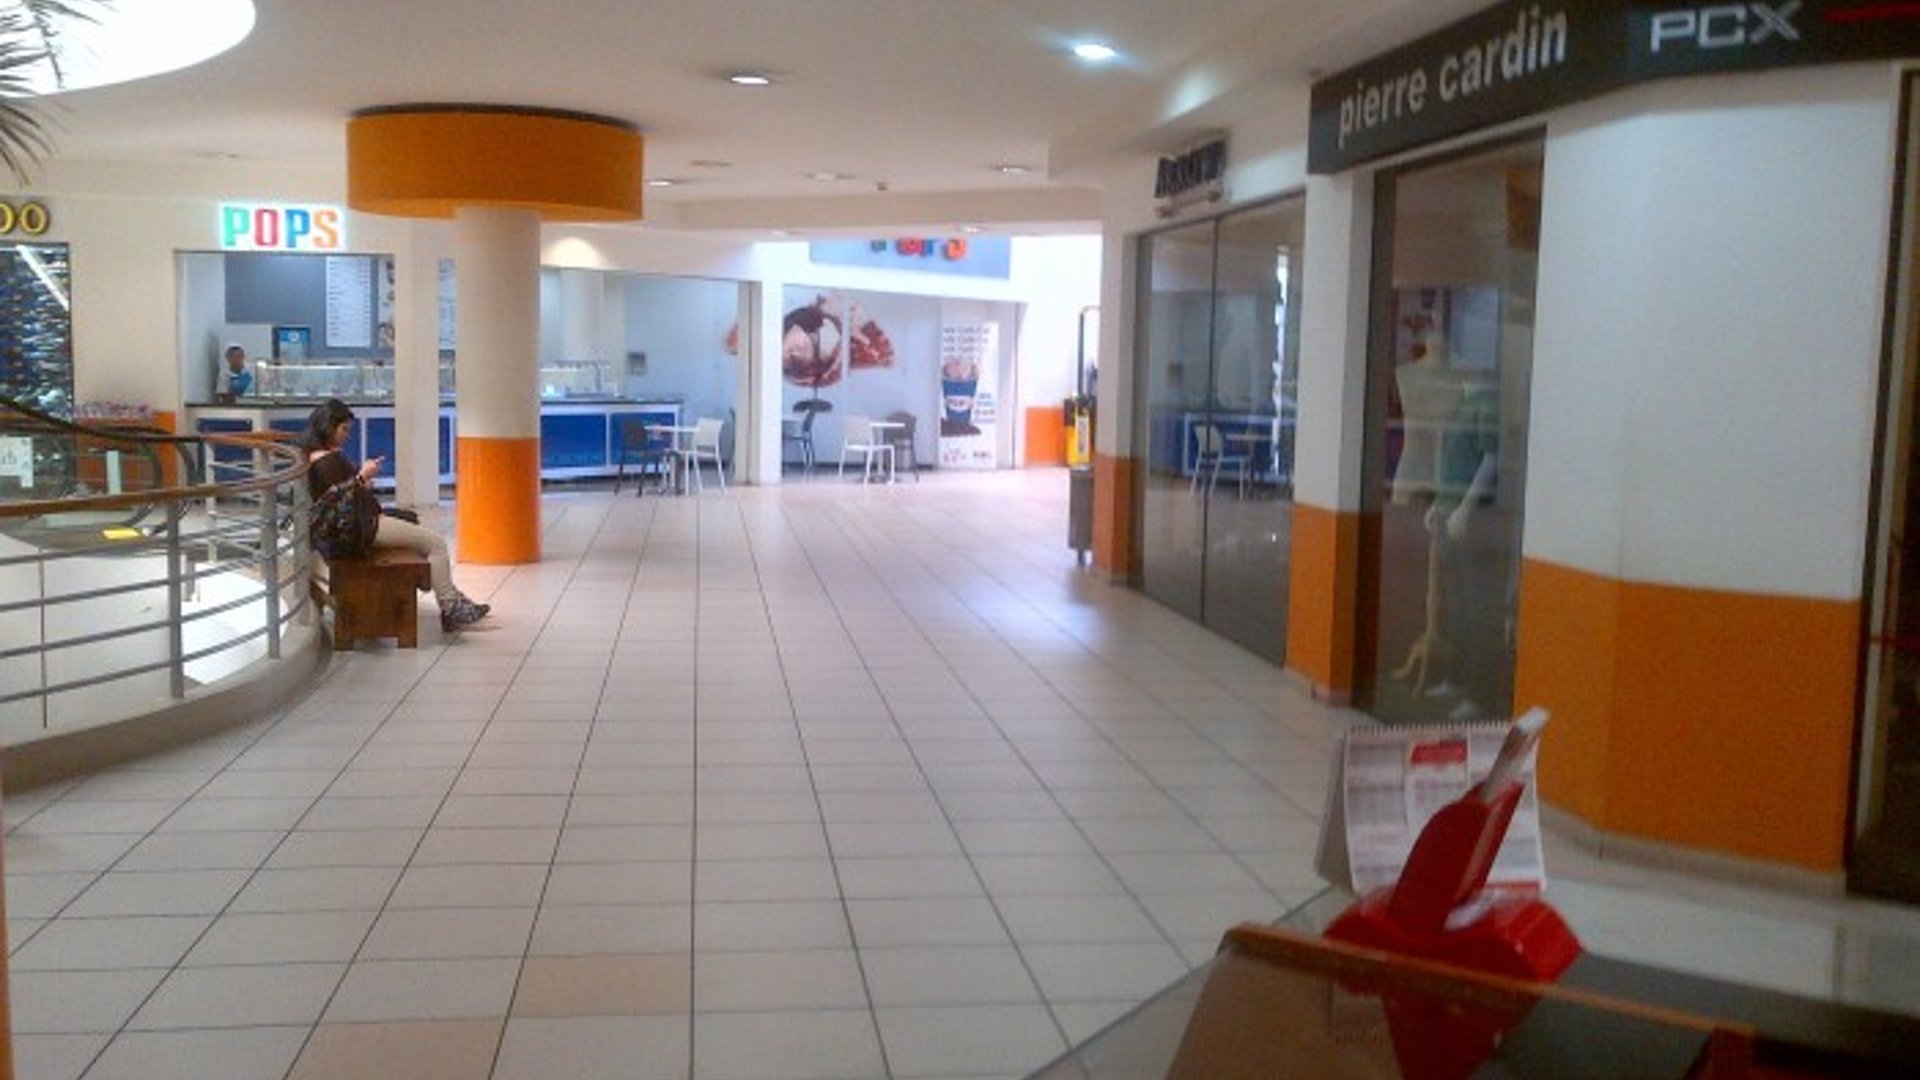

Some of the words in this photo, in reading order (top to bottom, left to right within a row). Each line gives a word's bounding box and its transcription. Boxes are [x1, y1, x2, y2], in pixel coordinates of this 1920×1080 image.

[1651, 2, 1801, 52] PCX
[1338, 68, 1427, 149] pierre
[1439, 5, 1568, 102] cardin
[223, 206, 339, 249] POPS
